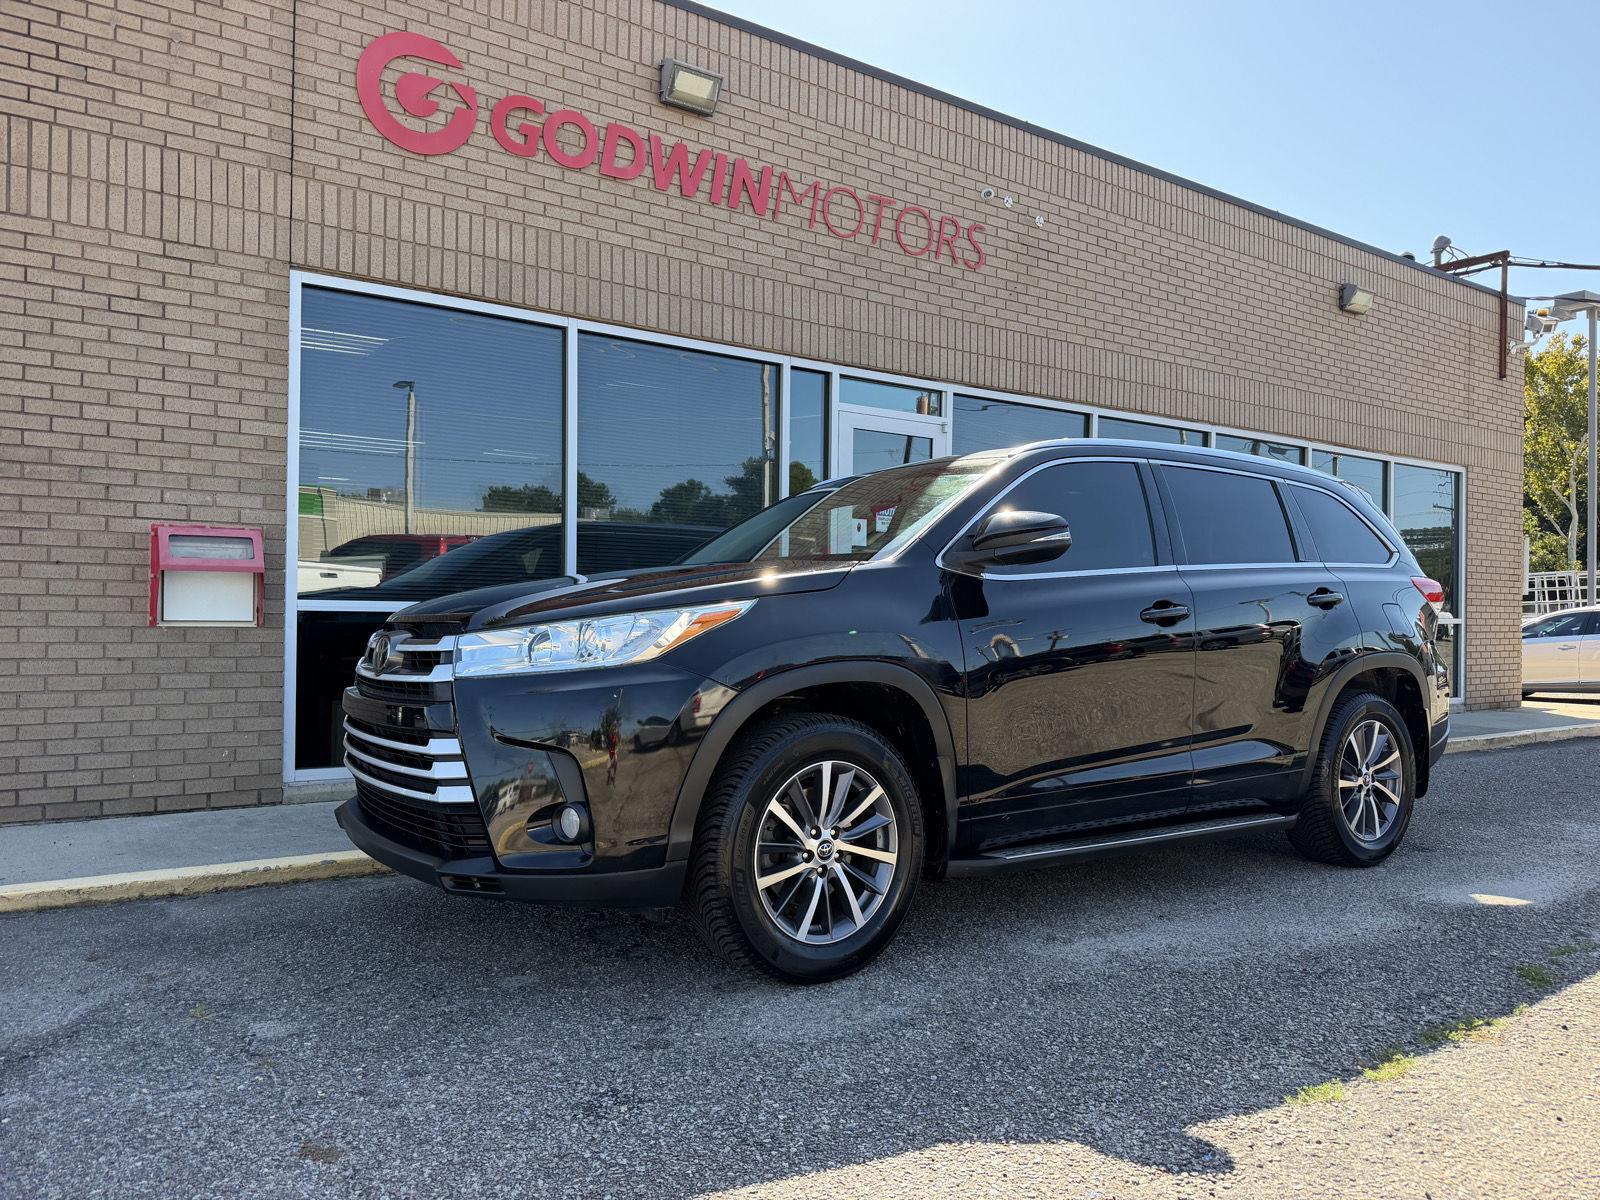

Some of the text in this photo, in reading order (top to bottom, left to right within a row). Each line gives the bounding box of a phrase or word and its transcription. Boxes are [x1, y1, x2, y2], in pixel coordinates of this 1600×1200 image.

[490, 95, 987, 270] GODWIN MOTORS
[897, 775, 922, 835] MICHELIN
